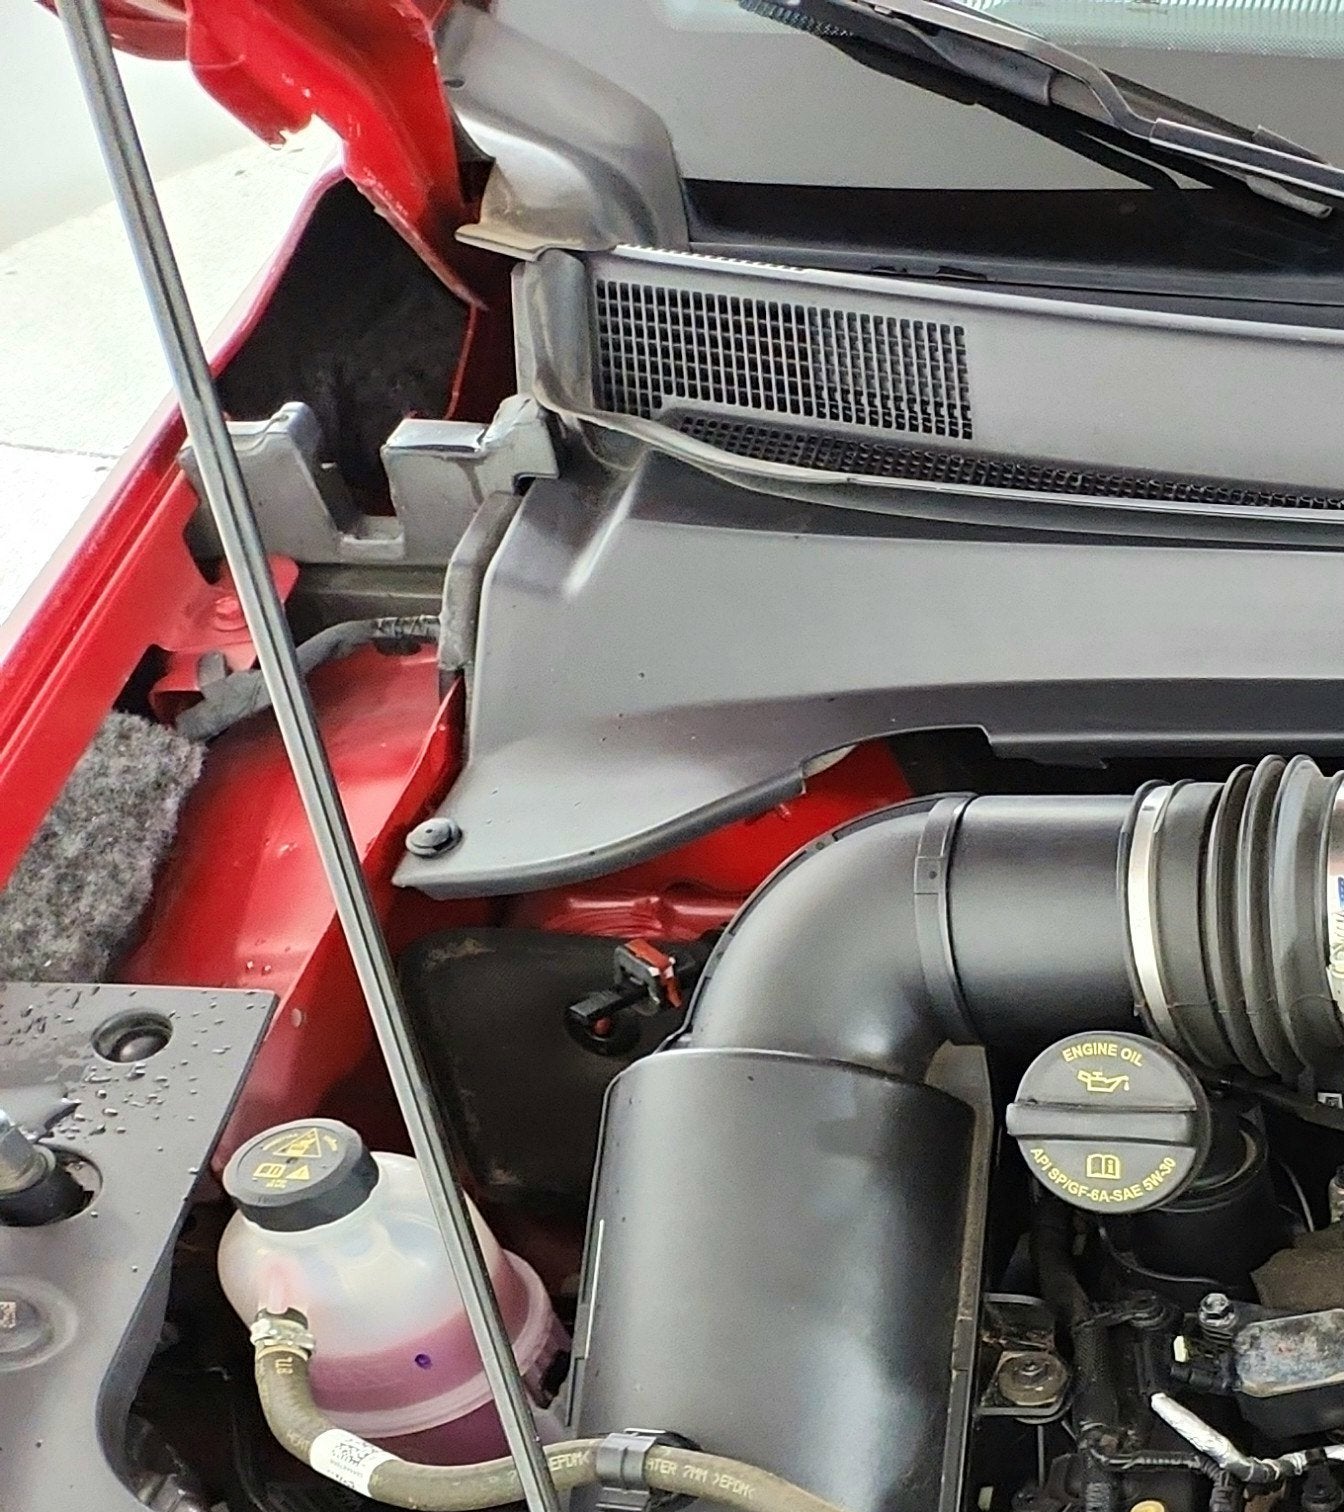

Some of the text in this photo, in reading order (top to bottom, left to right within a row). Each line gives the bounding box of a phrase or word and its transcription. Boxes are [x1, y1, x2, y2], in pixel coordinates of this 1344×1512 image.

[1062, 1042, 1144, 1067] ENGINE OIL
[1030, 1147, 1052, 1171] API
[1142, 1157, 1177, 1192] 5W-30
